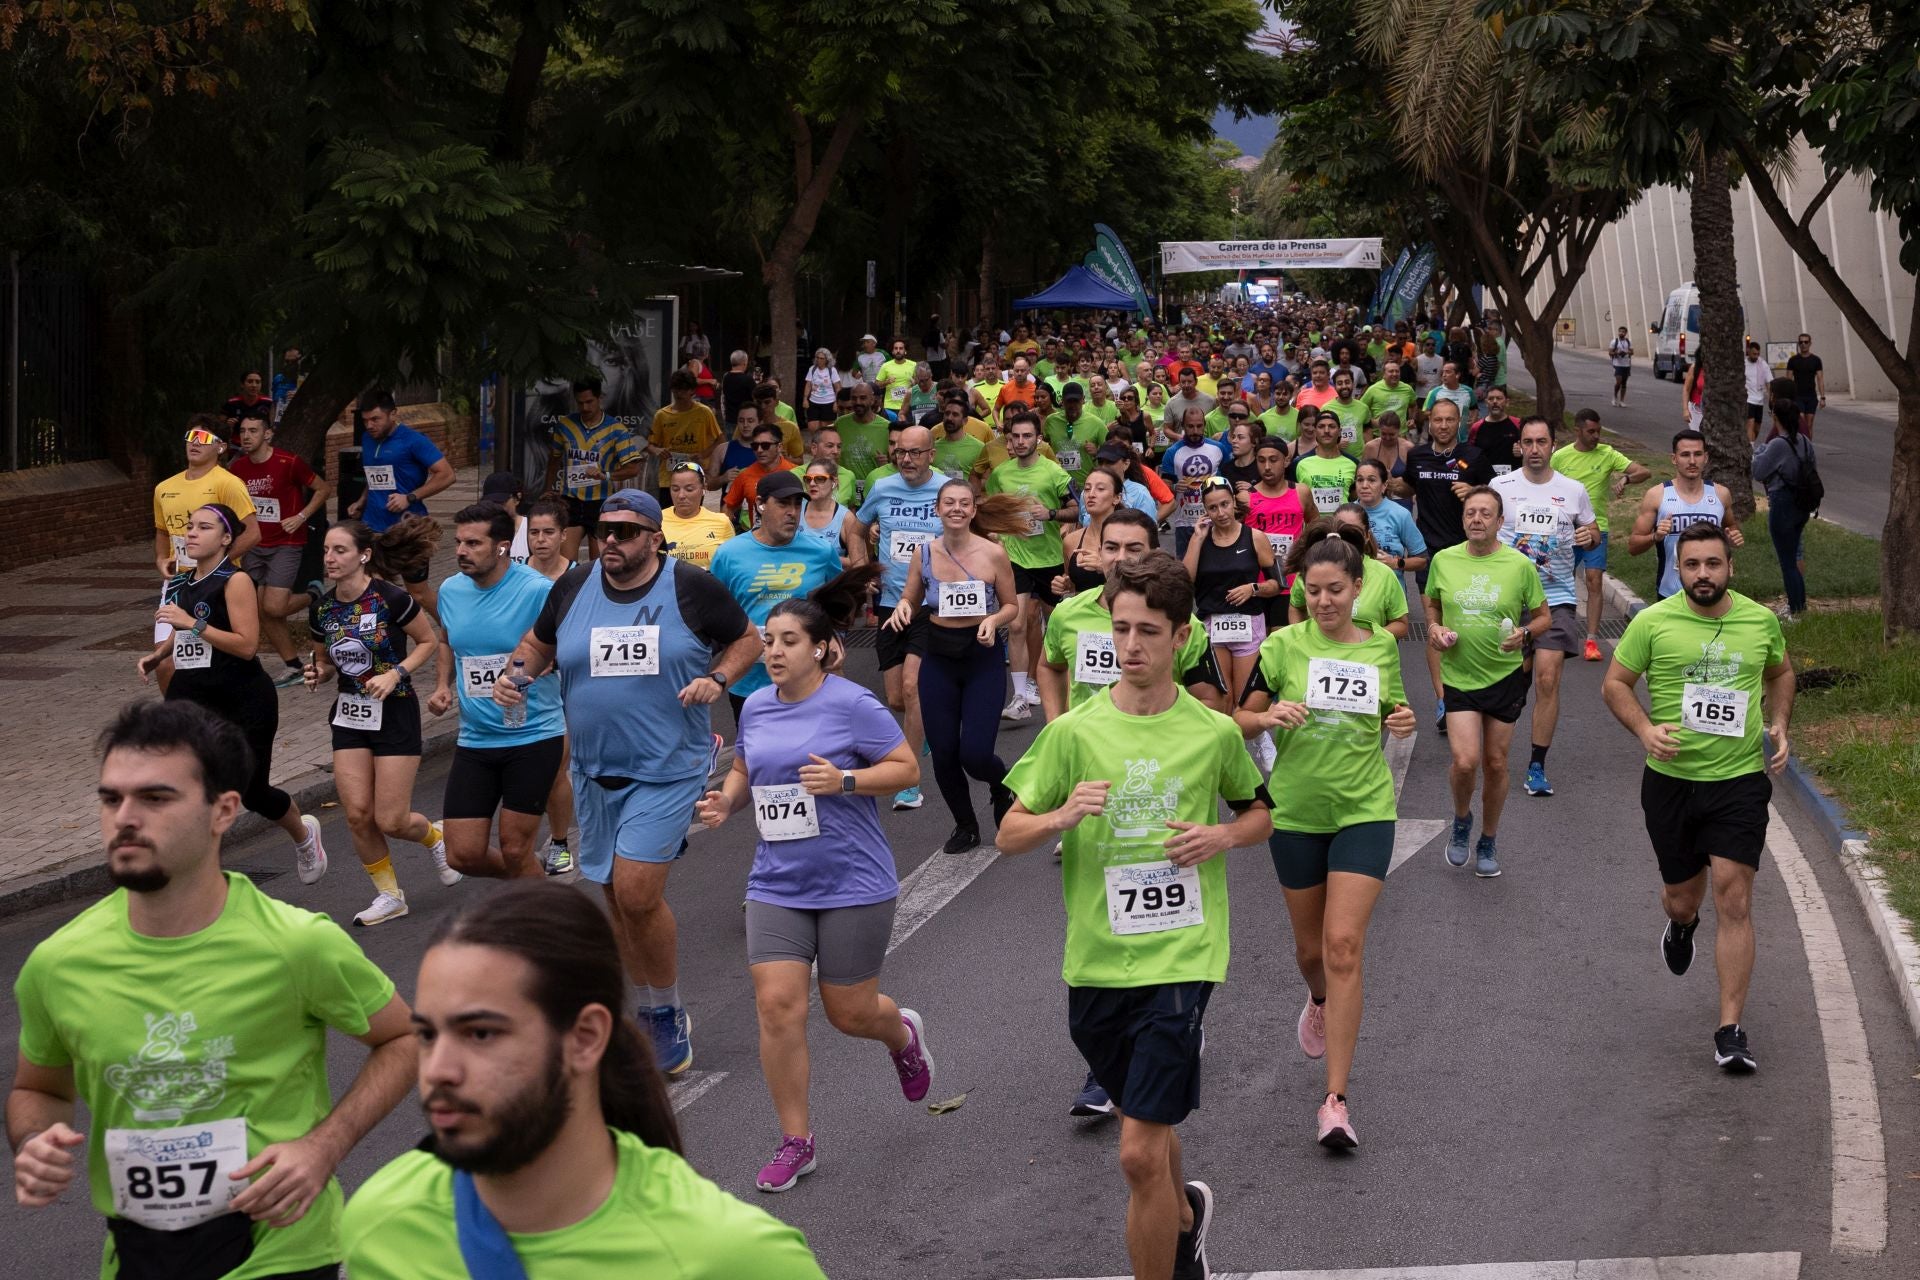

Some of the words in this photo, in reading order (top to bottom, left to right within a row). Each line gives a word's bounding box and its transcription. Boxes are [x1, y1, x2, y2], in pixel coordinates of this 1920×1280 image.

[1218, 242, 1259, 252] Carrera
[1262, 242, 1275, 251] de
[1278, 242, 1288, 251] la
[1290, 241, 1327, 250] Prensa
[370, 473, 389, 483] 107
[1419, 471, 1433, 479] DIE
[1433, 472, 1459, 480] HARD
[1315, 495, 1340, 504] 1136
[1520, 512, 1553, 524] 1107
[945, 593, 978, 607] 109
[1214, 621, 1247, 631] 1059
[176, 642, 205, 658] 205
[599, 642, 647, 662] 719
[1317, 676, 1369, 697] 173
[341, 702, 372, 719] 825
[1691, 701, 1736, 723] 165
[757, 801, 809, 820] 1074
[1118, 883, 1187, 913] 799
[126, 1159, 218, 1200] 857
